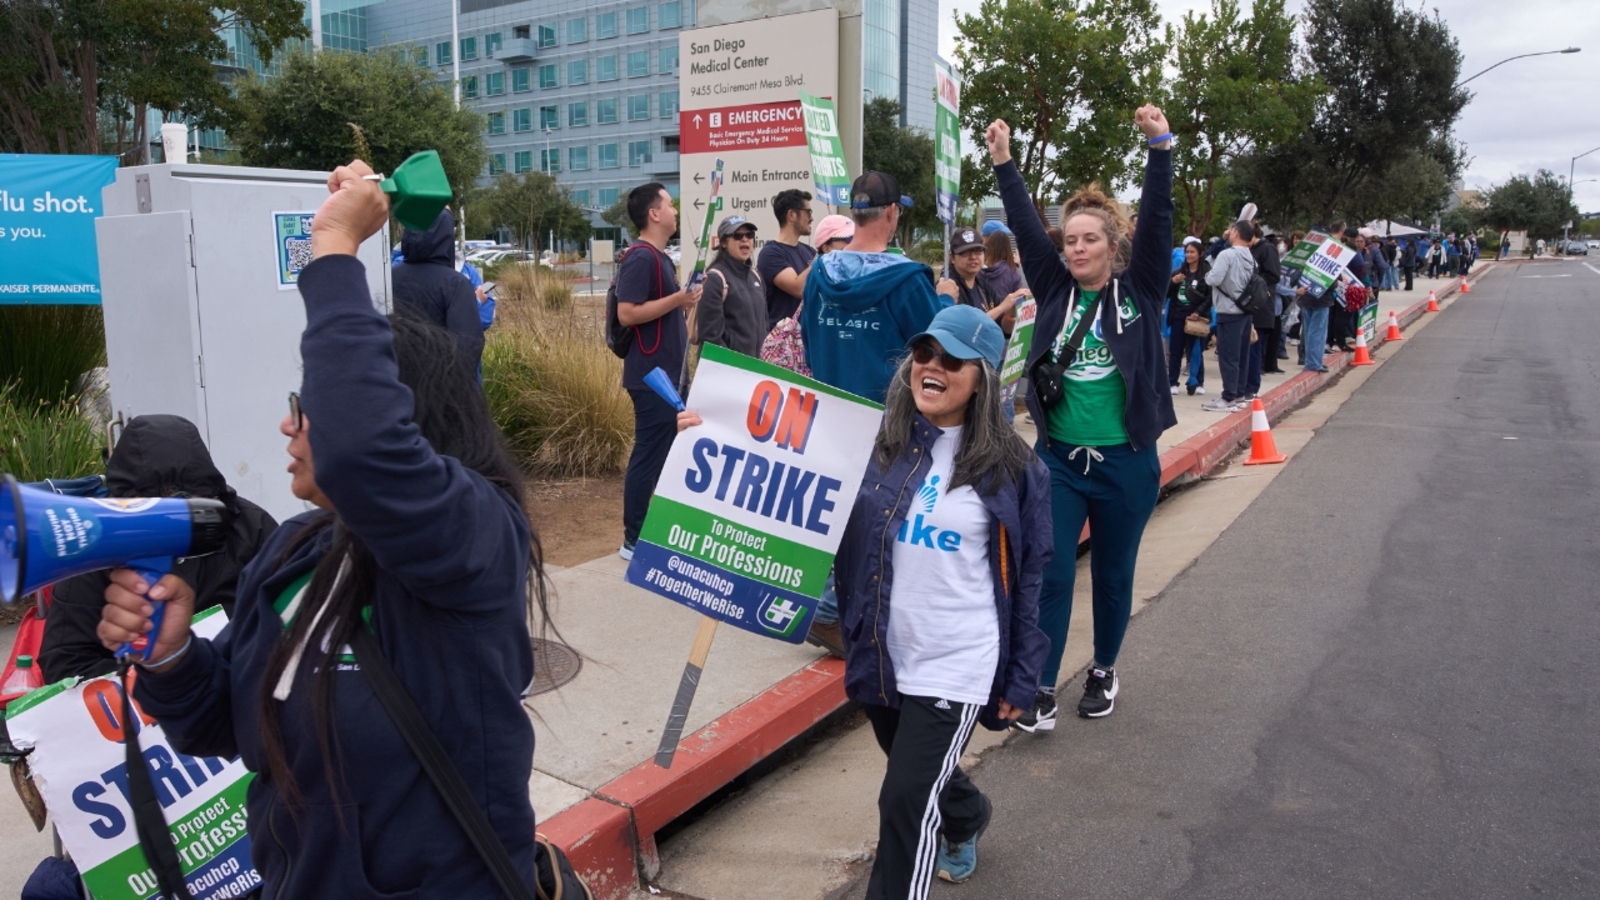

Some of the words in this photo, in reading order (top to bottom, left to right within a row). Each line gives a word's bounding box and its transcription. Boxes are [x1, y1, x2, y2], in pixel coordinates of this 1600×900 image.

[690, 42, 710, 55] San
[713, 38, 746, 53] Diego
[690, 57, 731, 75] Medical
[733, 56, 769, 70] Center
[690, 84, 712, 96] 9455
[713, 81, 758, 95] Clairemont
[759, 78, 782, 89] Mesa
[784, 73, 806, 87] Blvd.
[728, 106, 803, 125] EMERGENCY
[709, 131, 724, 139] Basic
[725, 128, 755, 139] Emergency
[756, 127, 780, 135] Medical
[709, 138, 736, 147] Physician
[746, 137, 761, 145] Duty
[770, 135, 789, 143] Hours
[731, 170, 758, 183] Main
[761, 169, 810, 181] Entrance
[33, 191, 94, 213] shot.
[731, 197, 768, 212] Urgent
[10, 227, 46, 242] you.
[1325, 243, 1344, 259] ON
[1309, 253, 1341, 276] STRIKE
[746, 379, 819, 455] ON
[684, 437, 842, 536] STRIKE
[60, 519, 78, 541] NOT
[710, 519, 724, 536] To
[724, 524, 767, 552] Protect
[667, 524, 701, 552] Our
[700, 534, 804, 588] Professions
[667, 555, 735, 597] @unacuhcp
[644, 567, 745, 620] #TogetherWeRise
[177, 796, 231, 839] Protect
